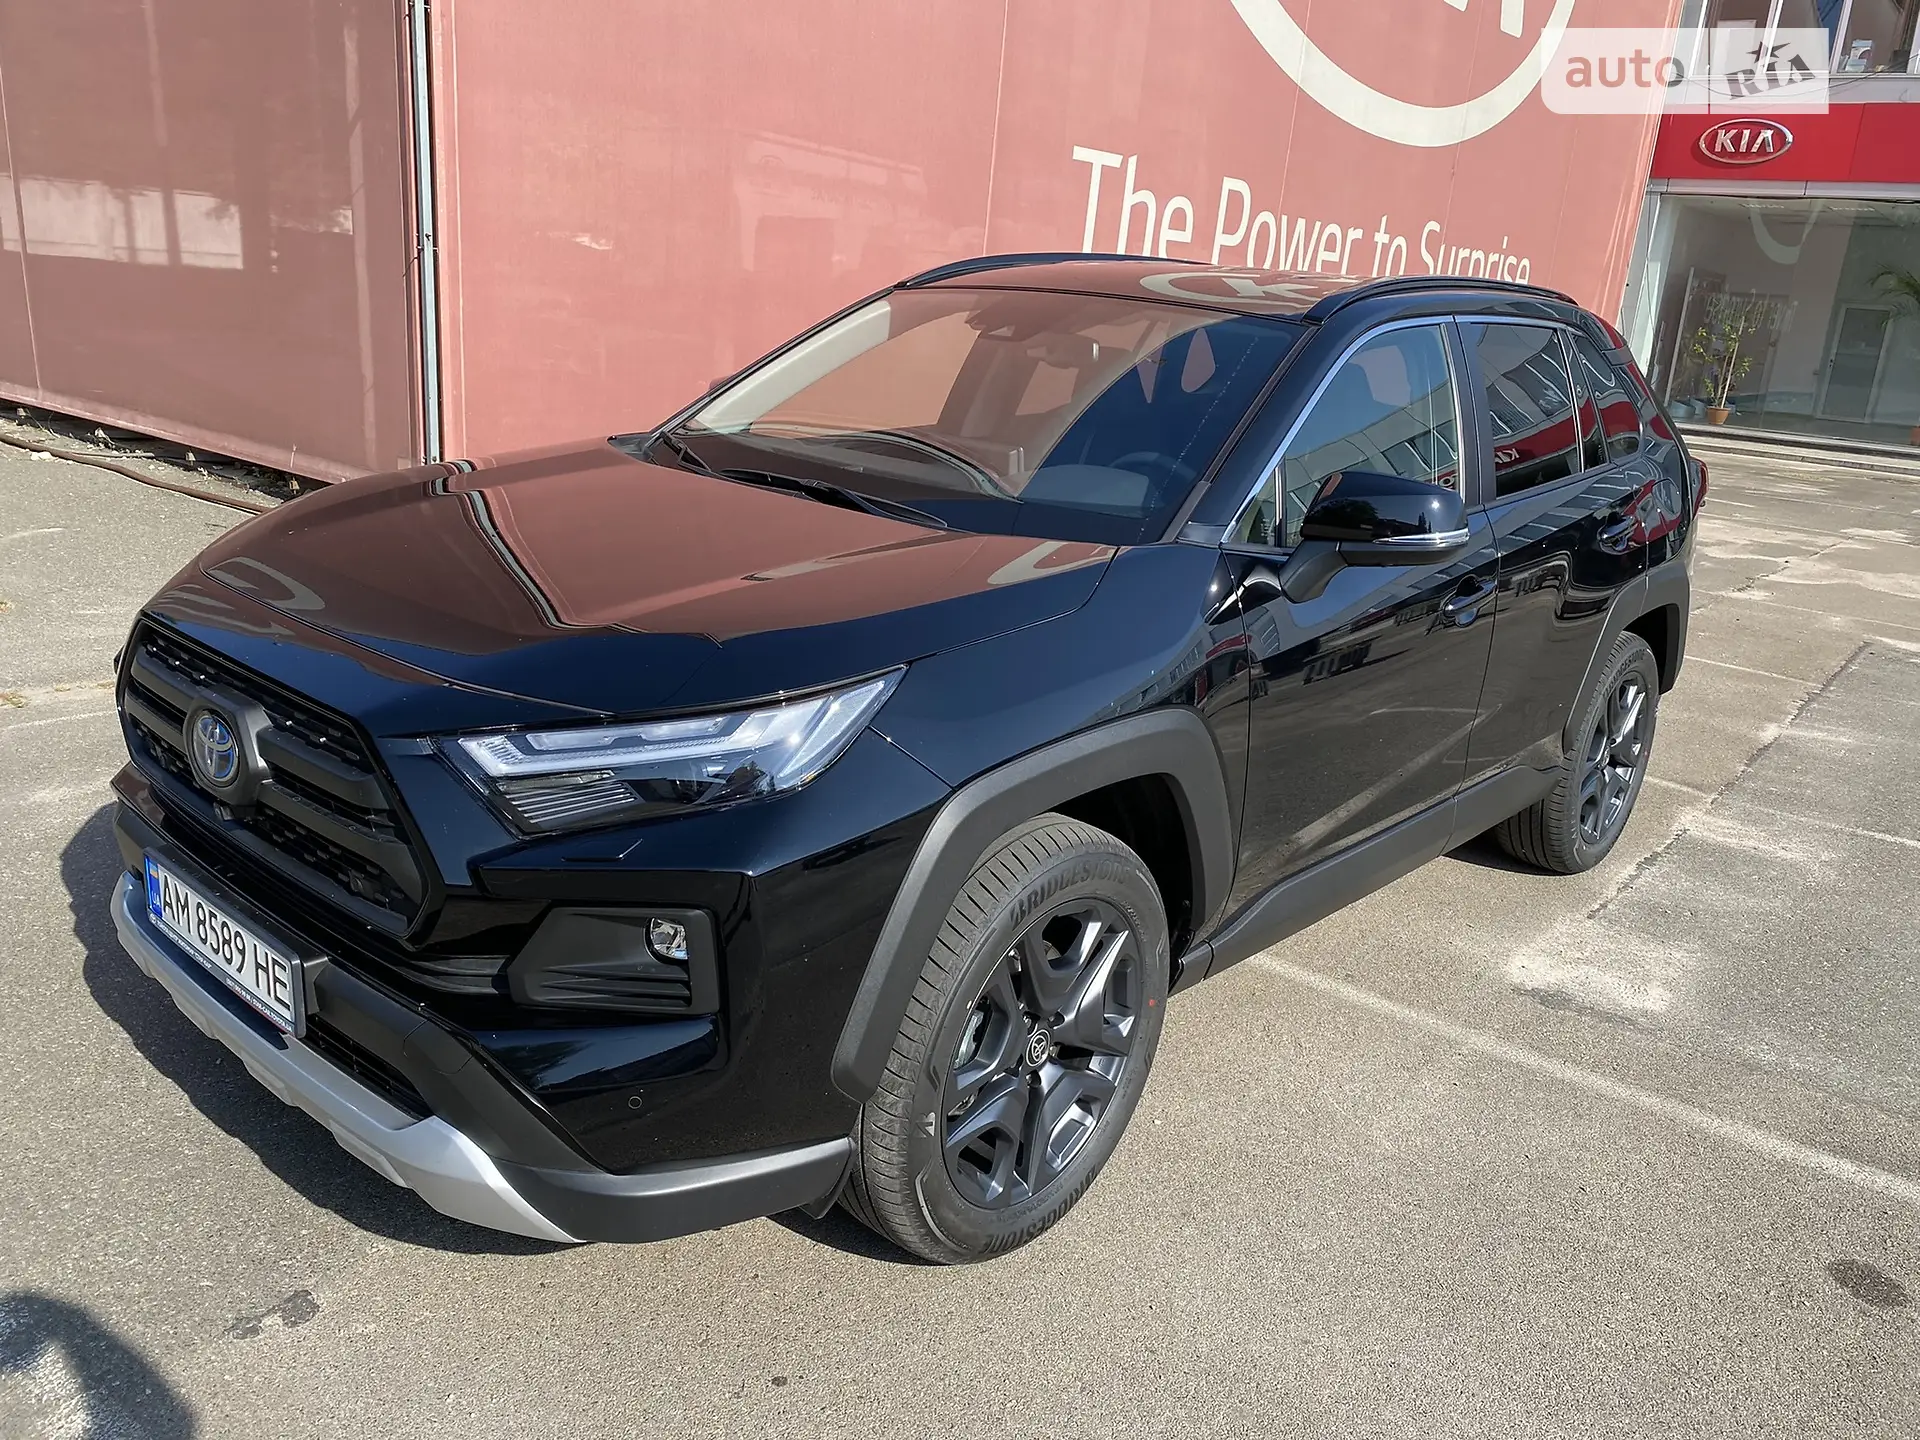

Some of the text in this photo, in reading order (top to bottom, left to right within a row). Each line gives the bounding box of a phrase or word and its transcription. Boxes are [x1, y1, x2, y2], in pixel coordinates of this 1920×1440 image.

[1714, 129, 1774, 153] KIA
[1072, 145, 1530, 285] The Power to Surprise
[151, 890, 161, 907] UA
[1009, 859, 1131, 932] BRIDGESTONE
[163, 873, 192, 935] AM
[196, 901, 246, 974] 8589
[253, 941, 291, 1011] HE
